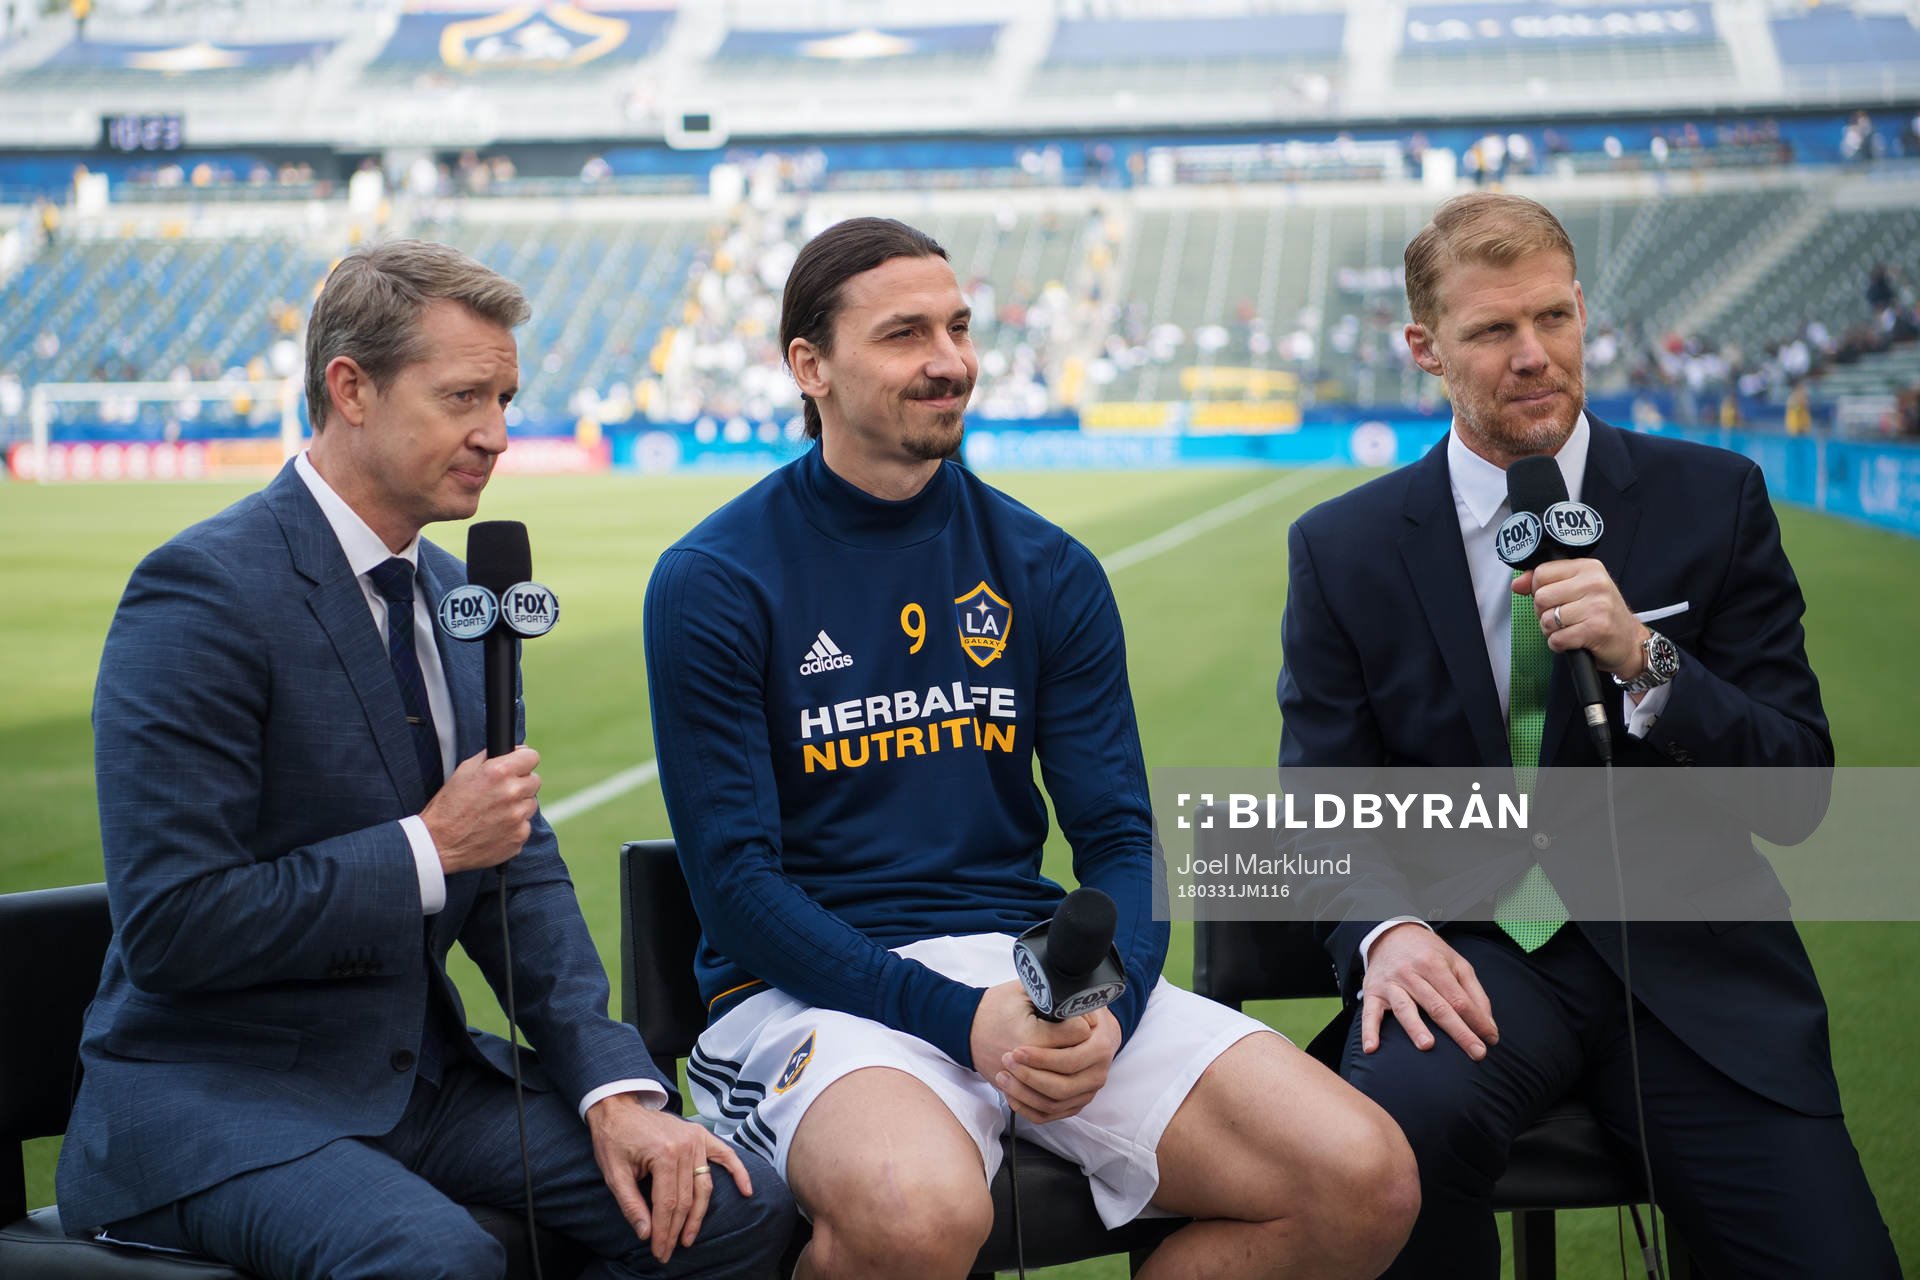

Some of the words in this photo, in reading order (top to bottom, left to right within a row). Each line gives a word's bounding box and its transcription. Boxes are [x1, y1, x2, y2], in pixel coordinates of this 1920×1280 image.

[1554, 510, 1591, 529] FOX
[1502, 518, 1532, 548] FOX
[1558, 528, 1594, 536] SPORTS
[1506, 536, 1534, 556] SPORTS
[450, 595, 485, 620] FOX
[514, 593, 548, 614] FOX
[450, 616, 487, 629] SPORTS
[514, 614, 549, 623] SPORTS
[900, 602, 927, 655] 9
[966, 612, 1000, 636] LA
[964, 638, 1001, 647] GALAXY
[800, 653, 854, 676] adidas
[801, 681, 1017, 739] HERBALFE
[1020, 952, 1047, 999] FOX
[1070, 986, 1113, 1010] FOX
